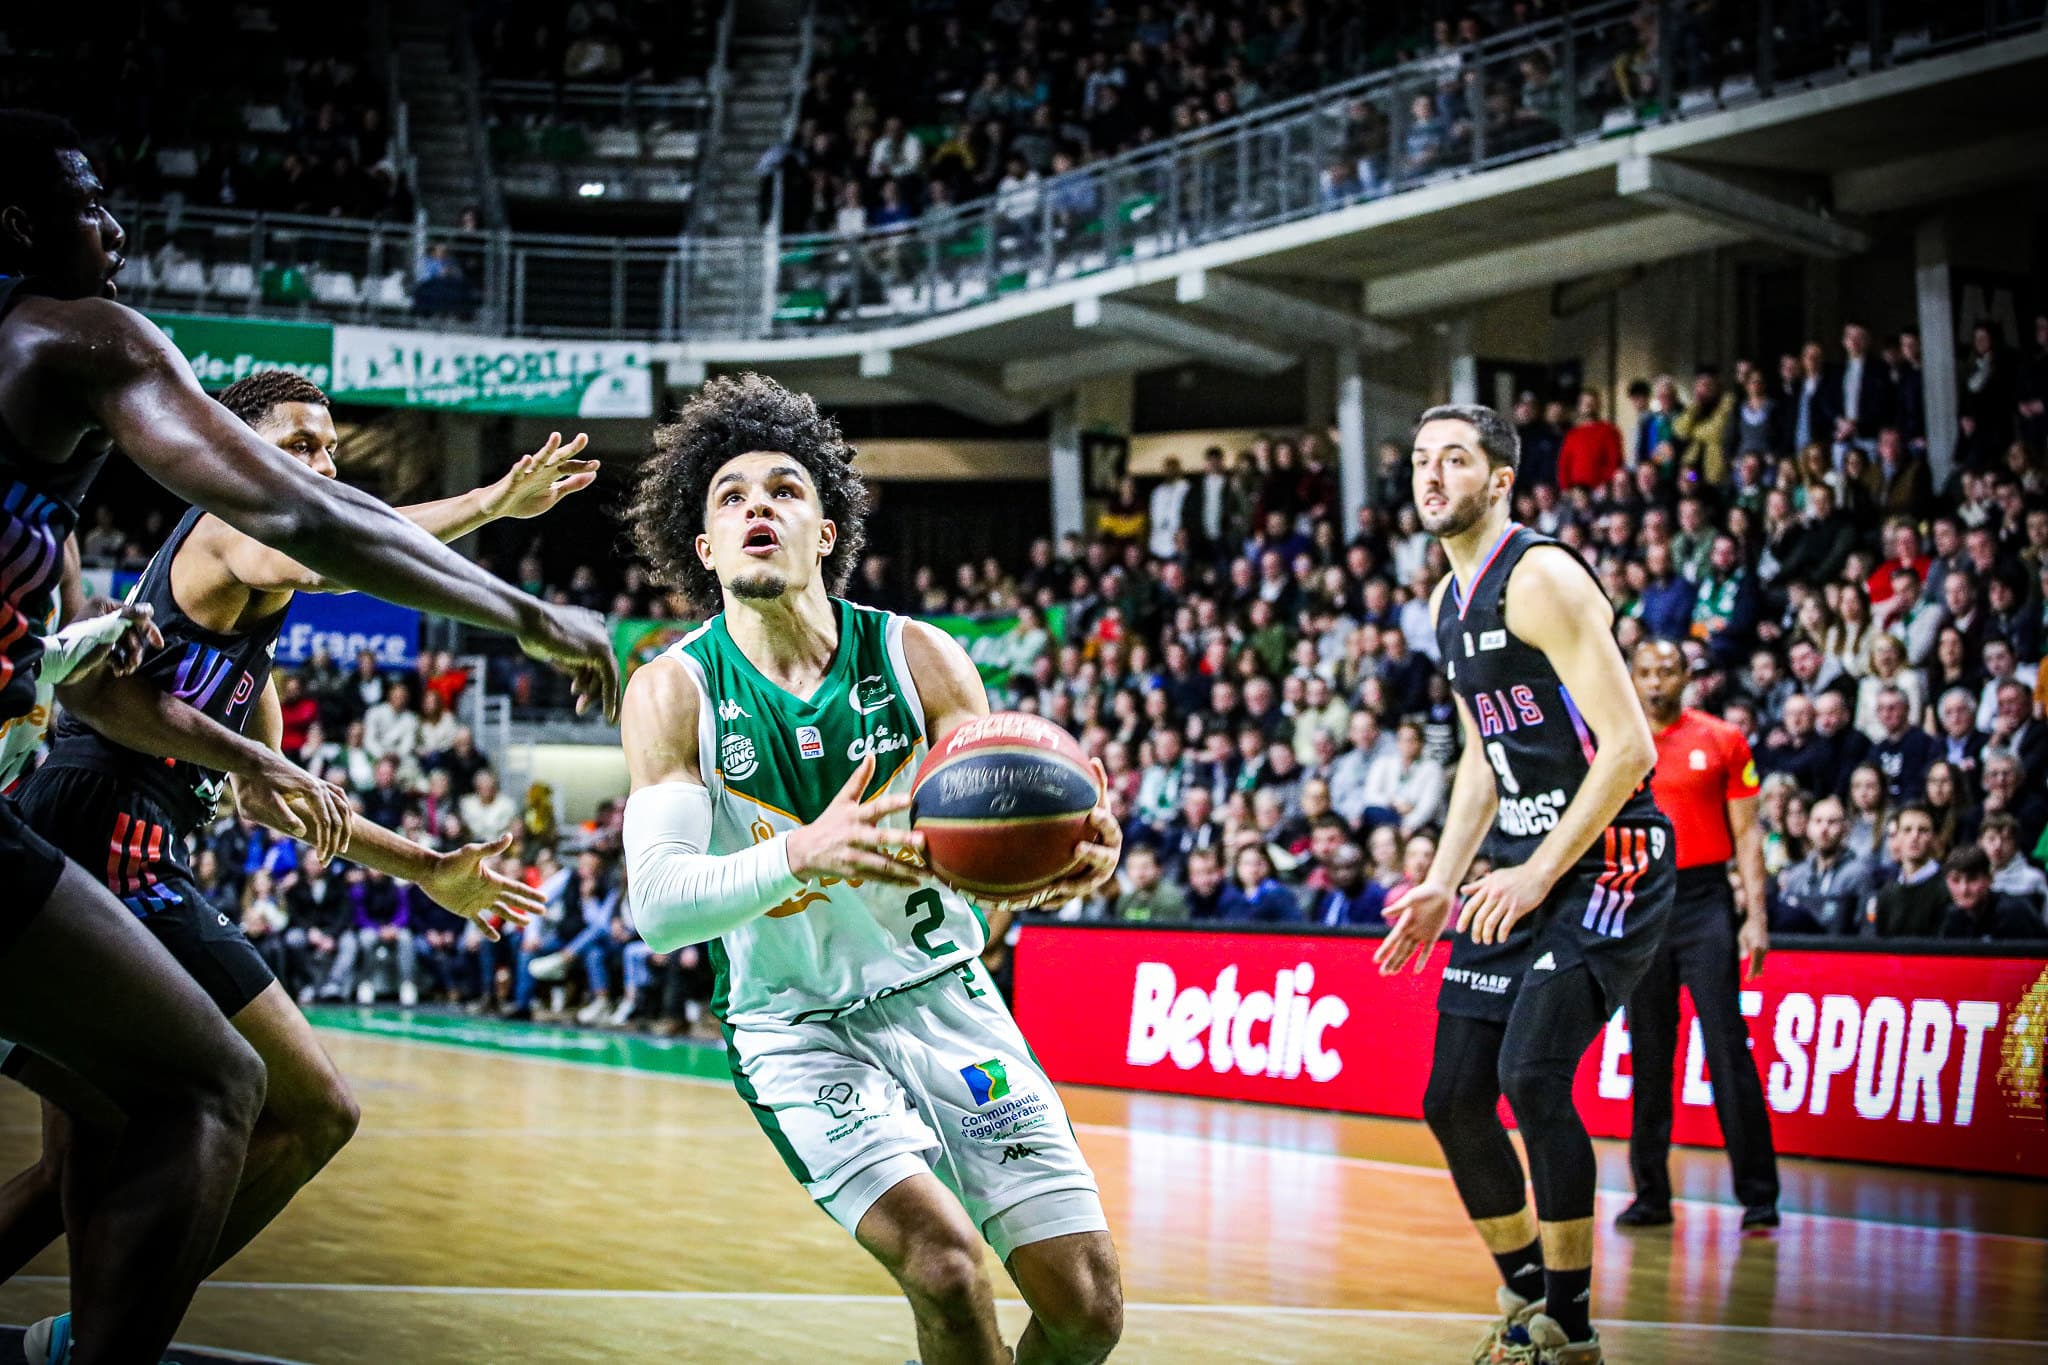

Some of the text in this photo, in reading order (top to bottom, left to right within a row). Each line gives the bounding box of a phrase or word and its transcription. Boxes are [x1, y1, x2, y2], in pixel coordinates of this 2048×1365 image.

[1487, 741, 1519, 793] 9
[1650, 826, 1666, 860] 9
[905, 887, 960, 959] 2
[1126, 961, 1350, 1082] Betclic
[1768, 992, 1999, 1126] SPORT
[961, 1103, 1049, 1138] d'agglomération
[962, 1091, 1041, 1127] Communauté
